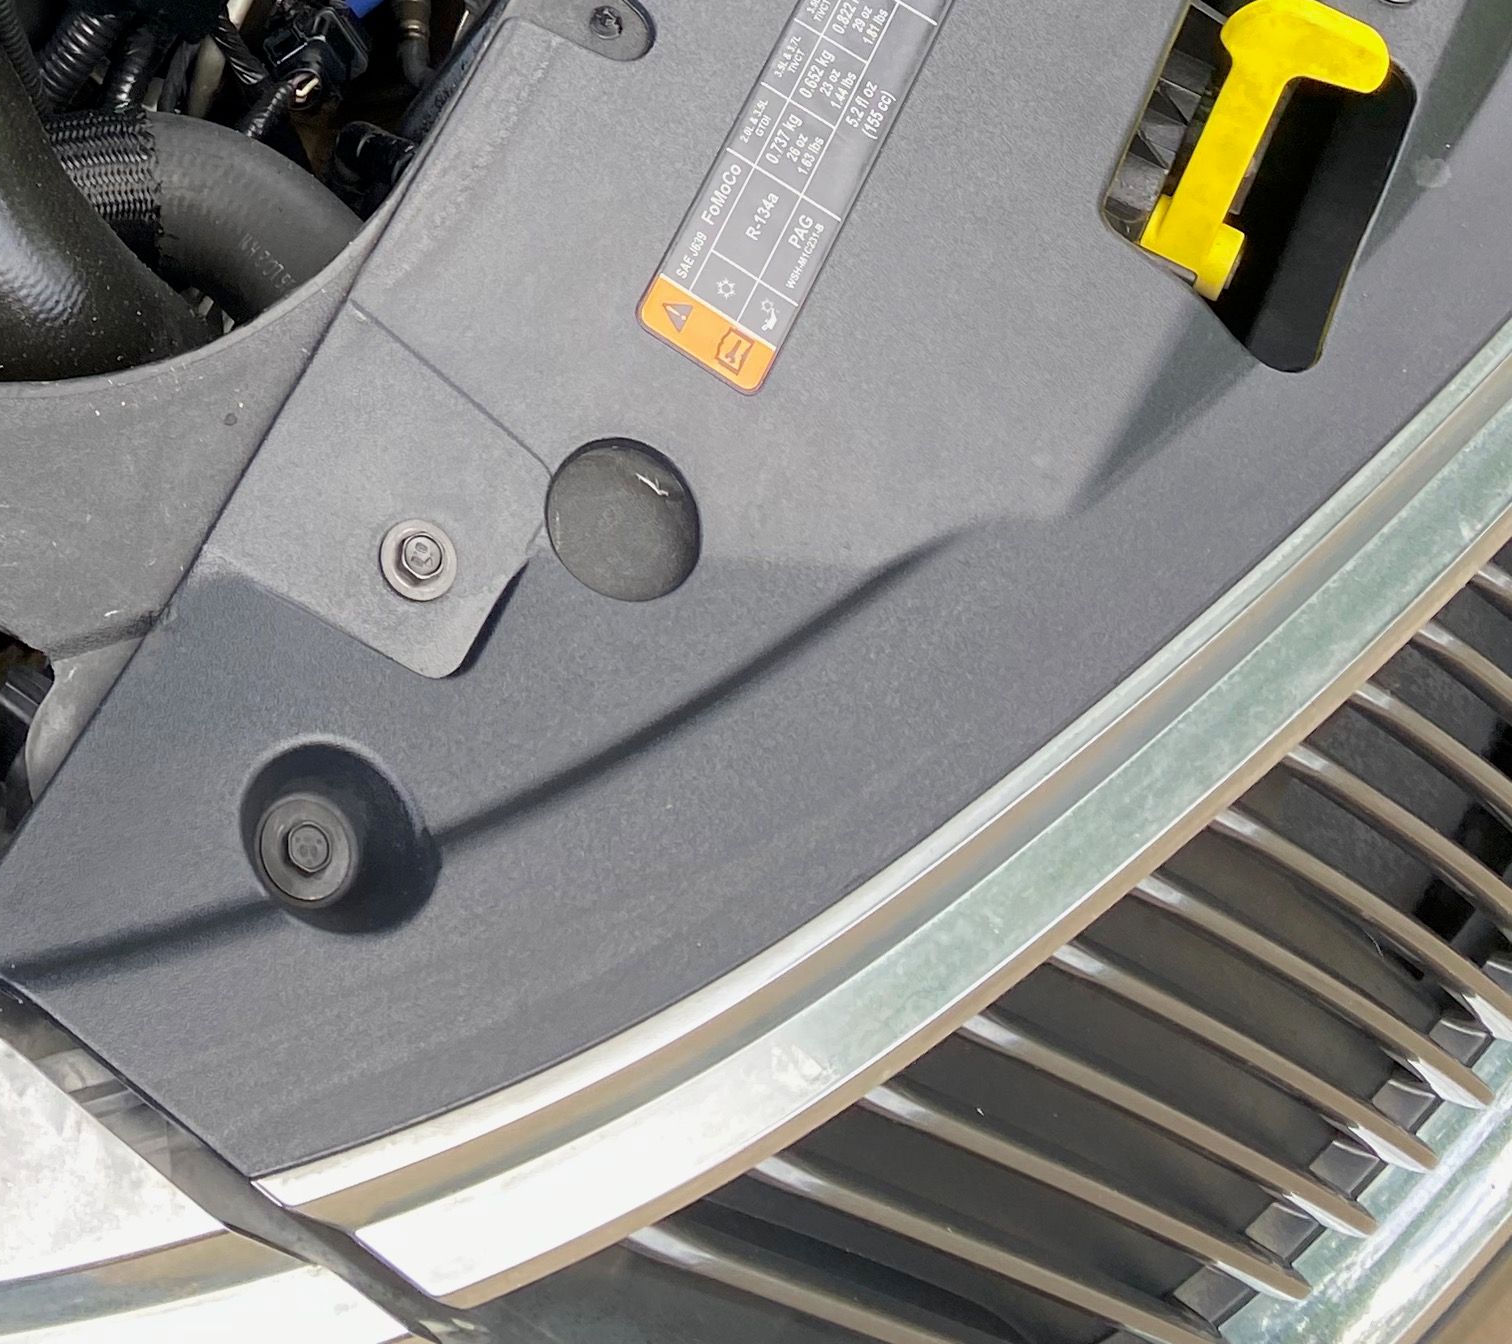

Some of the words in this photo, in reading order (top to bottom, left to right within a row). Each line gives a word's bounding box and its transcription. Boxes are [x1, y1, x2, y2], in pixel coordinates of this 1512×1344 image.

[832, 1, 857, 35] 0.822
[852, 17, 866, 33] 29
[861, 5, 873, 20] oz
[862, 21, 882, 45] 1.81
[873, 9, 889, 27] lbs
[774, 58, 788, 78] 3.5L
[789, 35, 802, 54] 3.7L
[799, 64, 825, 98] 0.652
[815, 49, 836, 68] kg
[819, 81, 834, 97] 23
[829, 69, 842, 82] oz
[830, 86, 848, 109] 1.44
[841, 71, 857, 89] lbs
[863, 81, 878, 98] oz
[740, 123, 755, 144] 2.0L
[754, 99, 769, 117] 3.5L
[845, 106, 865, 128] 5.2
[854, 95, 870, 110] fl
[862, 109, 884, 140] (155
[877, 90, 897, 112] cc)
[766, 129, 790, 165] 0.737
[782, 113, 803, 132] kg
[786, 146, 801, 163] 26
[796, 133, 809, 148] oz
[798, 151, 816, 176] 1.63
[808, 136, 825, 154] lbs
[676, 254, 695, 279] SAE
[689, 231, 707, 257] J639
[701, 164, 742, 226] FoMoCo
[745, 192, 779, 241] R-134a
[788, 214, 814, 249] PAG
[785, 223, 825, 290] WSH-M1C231-B
